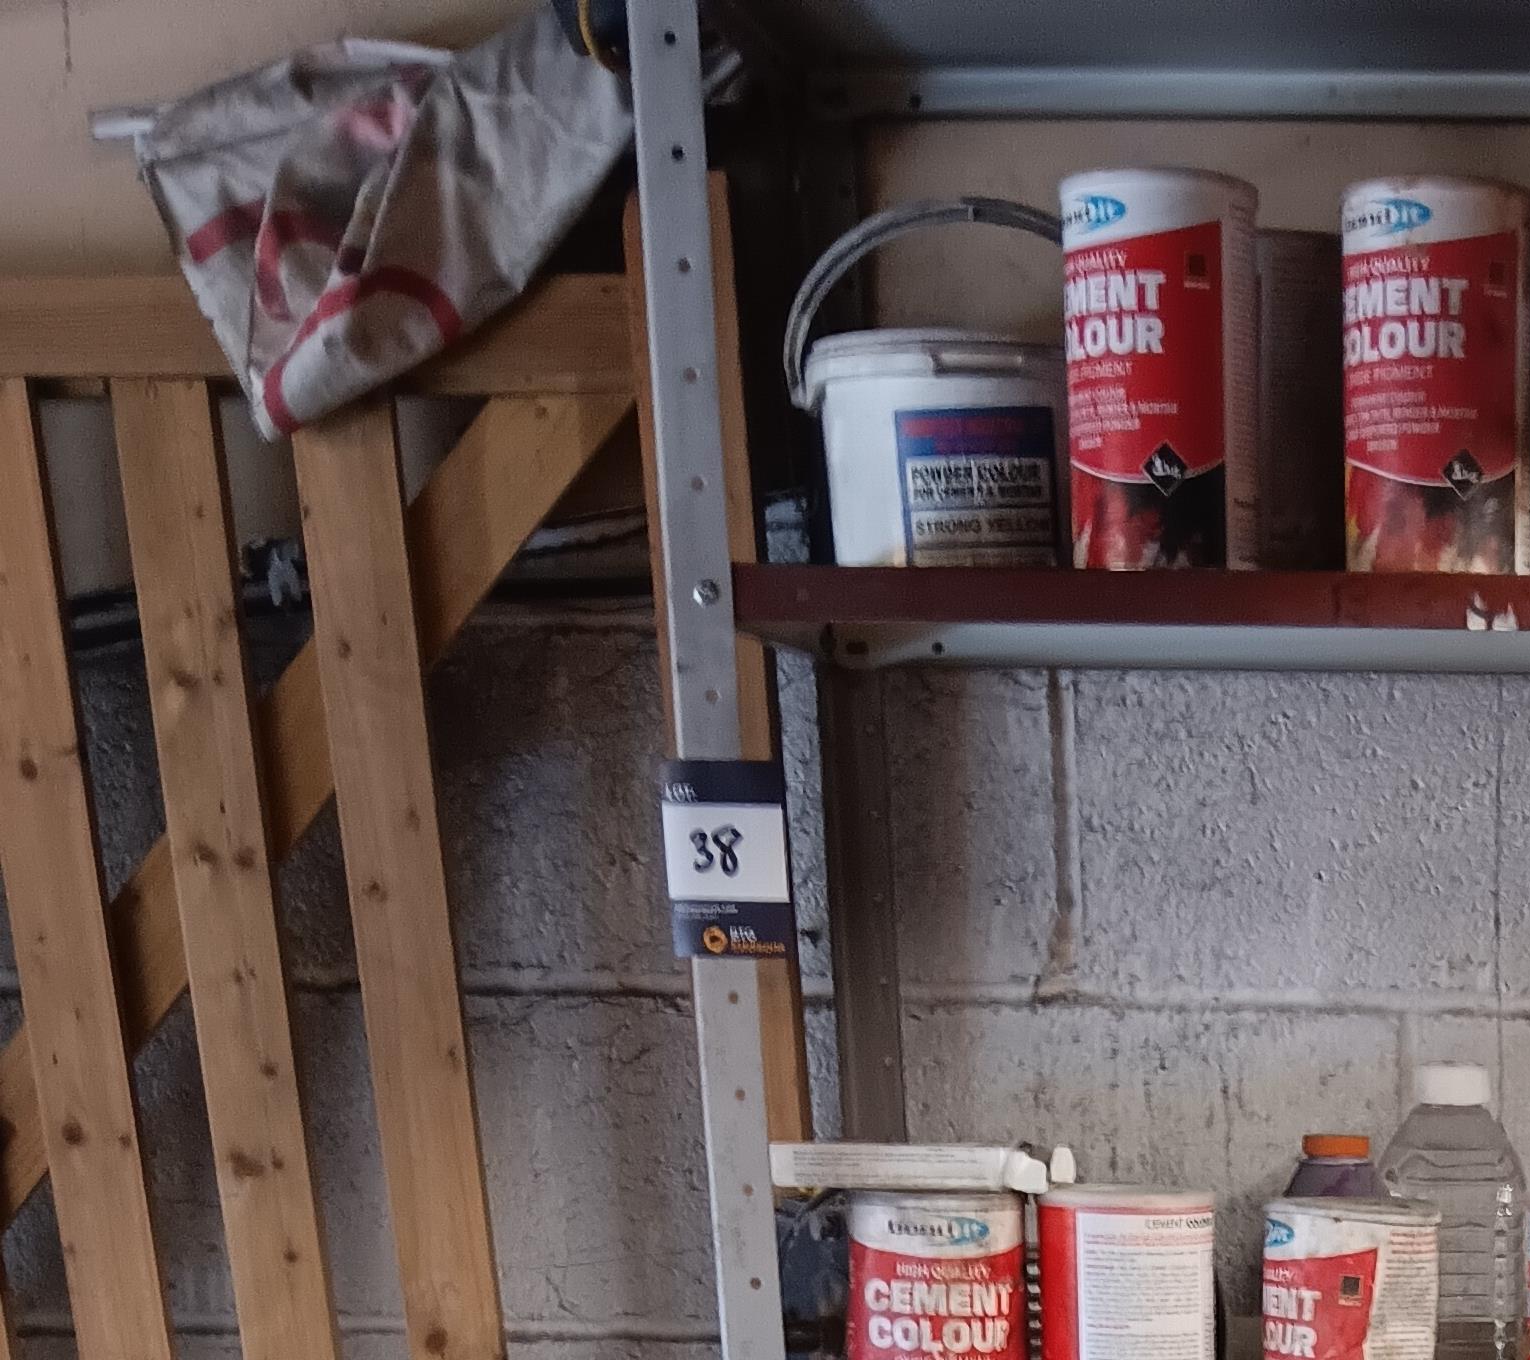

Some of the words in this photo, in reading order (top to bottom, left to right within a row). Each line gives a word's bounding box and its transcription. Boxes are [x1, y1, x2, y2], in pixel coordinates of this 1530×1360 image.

[1343, 276, 1469, 323] EMENT
[1343, 319, 1465, 367] OLOUR
[689, 824, 743, 878] 38
[864, 1278, 1012, 1316] CEMENT
[868, 1314, 1010, 1353] COLOUR
